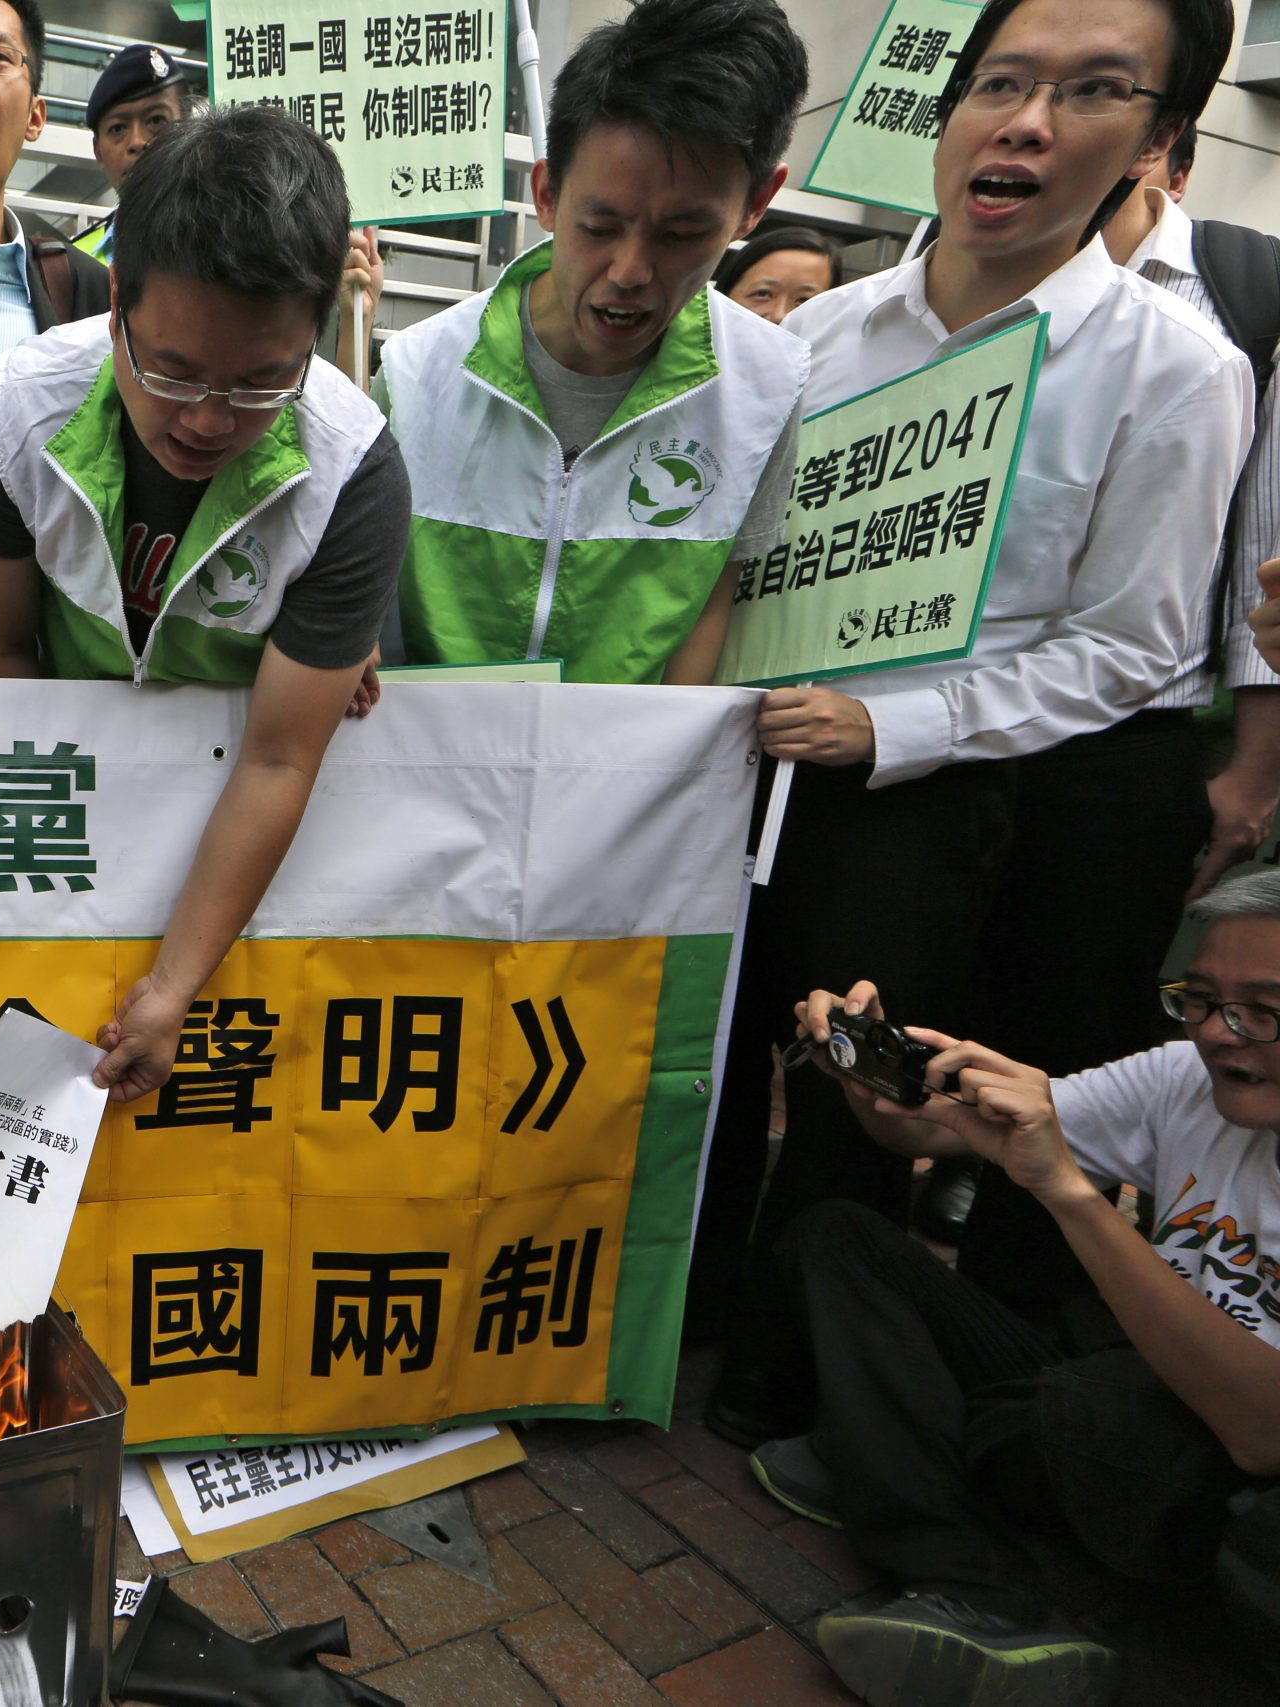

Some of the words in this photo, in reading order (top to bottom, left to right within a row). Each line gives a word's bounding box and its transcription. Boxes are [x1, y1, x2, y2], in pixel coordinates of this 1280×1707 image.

[225, 19, 347, 80] 強調一國
[364, 9, 494, 69] 埋沒兩制!
[230, 92, 346, 142] 順民
[362, 81, 492, 141] 你制唔制?
[853, 82, 942, 139] 奴隸順
[422, 163, 485, 194] 民主黨
[648, 438, 701, 457] 民主黨
[786, 382, 1014, 521] 等到2047
[871, 593, 957, 642] 民主黨
